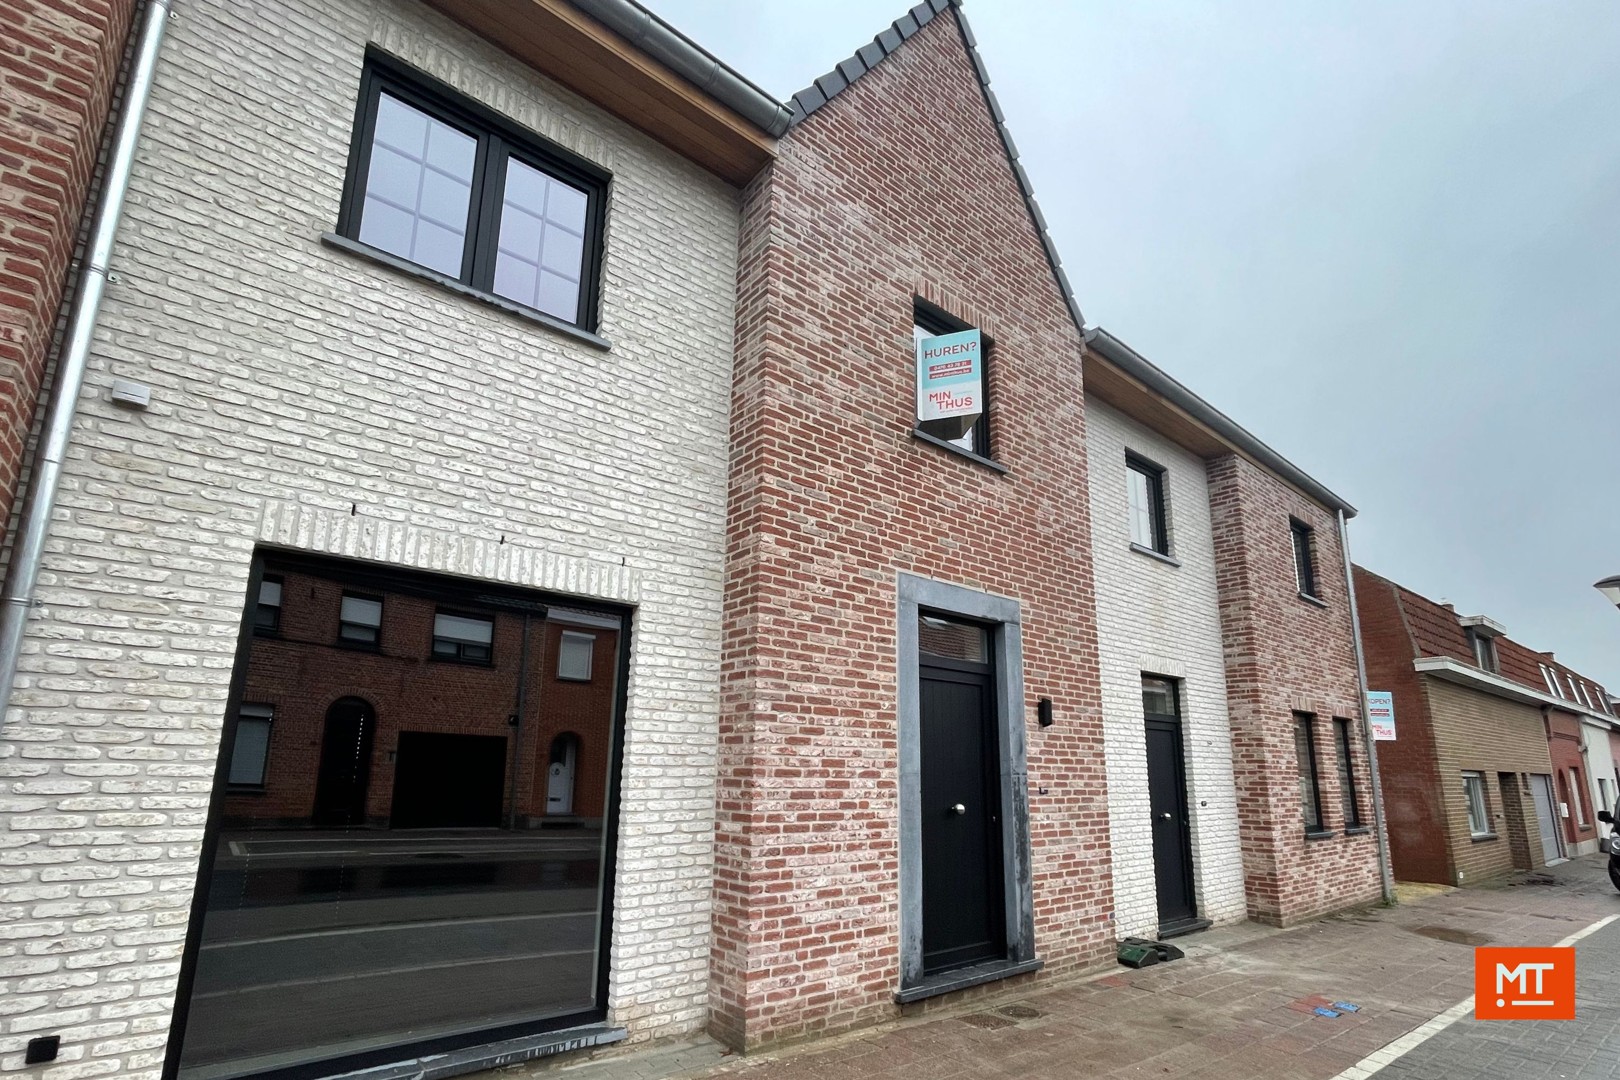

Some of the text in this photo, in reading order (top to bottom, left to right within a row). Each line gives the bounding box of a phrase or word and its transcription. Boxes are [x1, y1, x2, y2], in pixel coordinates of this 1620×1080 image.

[924, 341, 977, 359] HUREN?
[929, 391, 951, 402] MIN
[936, 397, 973, 410] THUS
